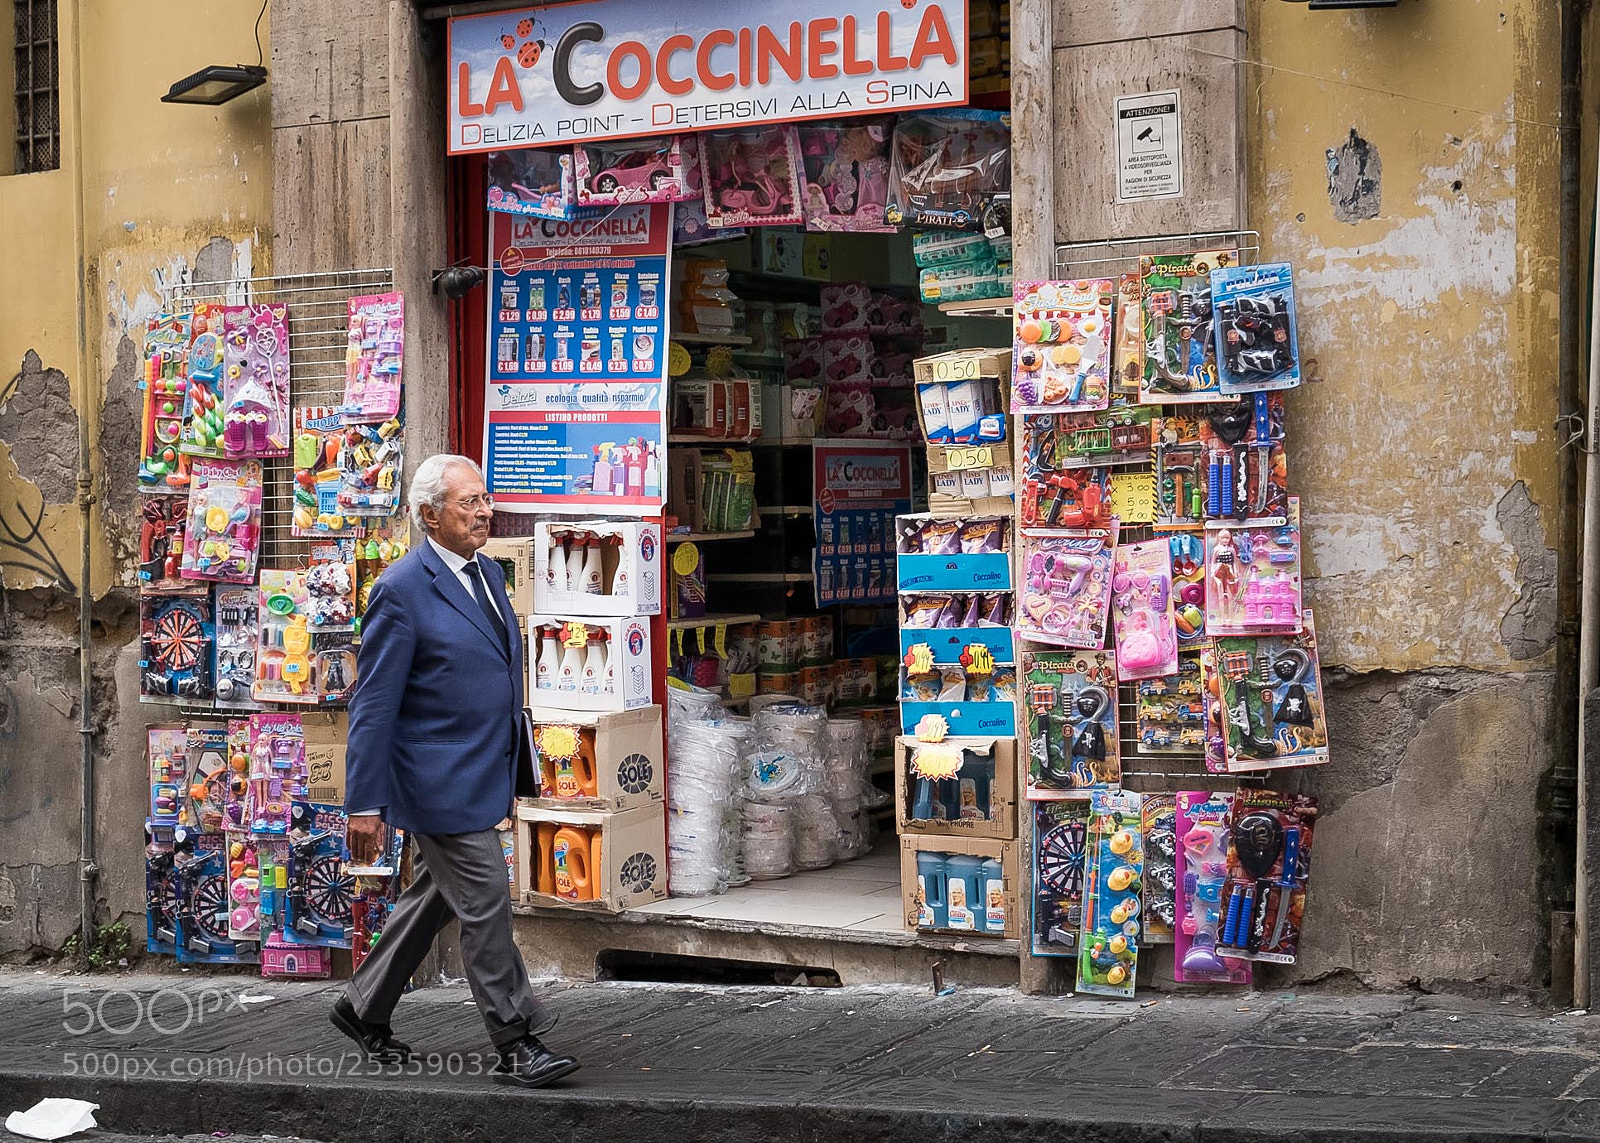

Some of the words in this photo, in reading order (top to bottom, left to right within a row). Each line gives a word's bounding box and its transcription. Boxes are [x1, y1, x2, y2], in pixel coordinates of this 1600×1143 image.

[457, 56, 524, 118] LA
[552, 5, 957, 107] COCCINELLA
[461, 122, 546, 146] DELIZIA
[556, 113, 624, 136] POINT
[652, 97, 778, 127] DETERSIVI
[790, 90, 850, 111] ALLA
[866, 80, 954, 106] SPINA
[1125, 107, 1170, 117] ATTENZIONE!
[1140, 153, 1168, 162] SOTTOPOSTA
[915, 213, 953, 225] PIRATI
[514, 222, 534, 240] LA
[541, 217, 648, 239] COCCINELLA
[546, 393, 577, 403] ecologia
[582, 391, 608, 403] qualità
[612, 392, 644, 402] risparmio
[545, 413, 571, 422] LISTINO
[573, 413, 608, 422] PRODOTTI
[828, 466, 841, 481] LA
[991, 474, 1011, 482] LADY
[936, 478, 957, 487] LADY
[964, 477, 984, 486] LADY
[973, 572, 1002, 583] Coccolino
[978, 720, 1007, 729] Coccolino
[621, 763, 651, 785] SOLE
[558, 781, 576, 790] SOLE
[624, 862, 656, 883] SOLE
[556, 877, 570, 888] SOLE
